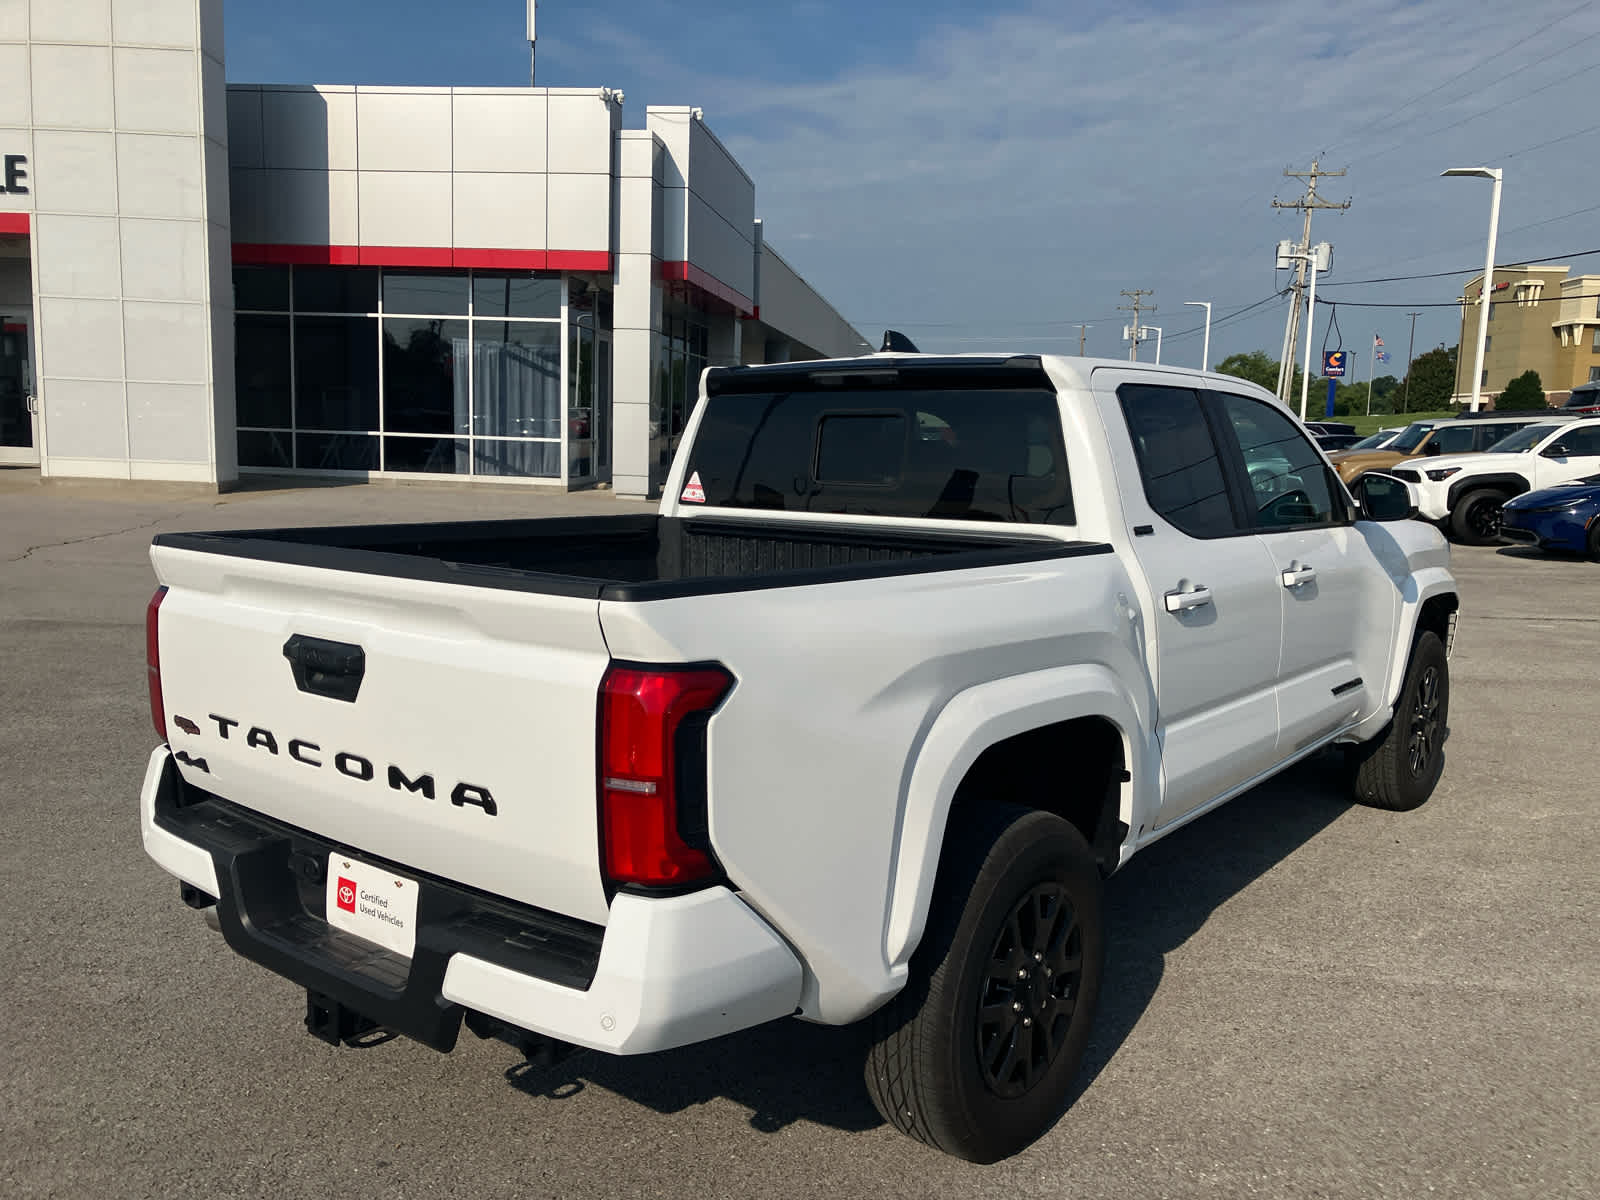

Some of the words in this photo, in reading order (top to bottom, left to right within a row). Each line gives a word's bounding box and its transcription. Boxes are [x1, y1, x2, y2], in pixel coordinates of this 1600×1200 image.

[0, 154, 29, 194] E
[208, 713, 498, 816] TACOMA
[360, 890, 388, 908] Certified
[359, 903, 376, 917] Used
[377, 910, 404, 928] Vehicles
